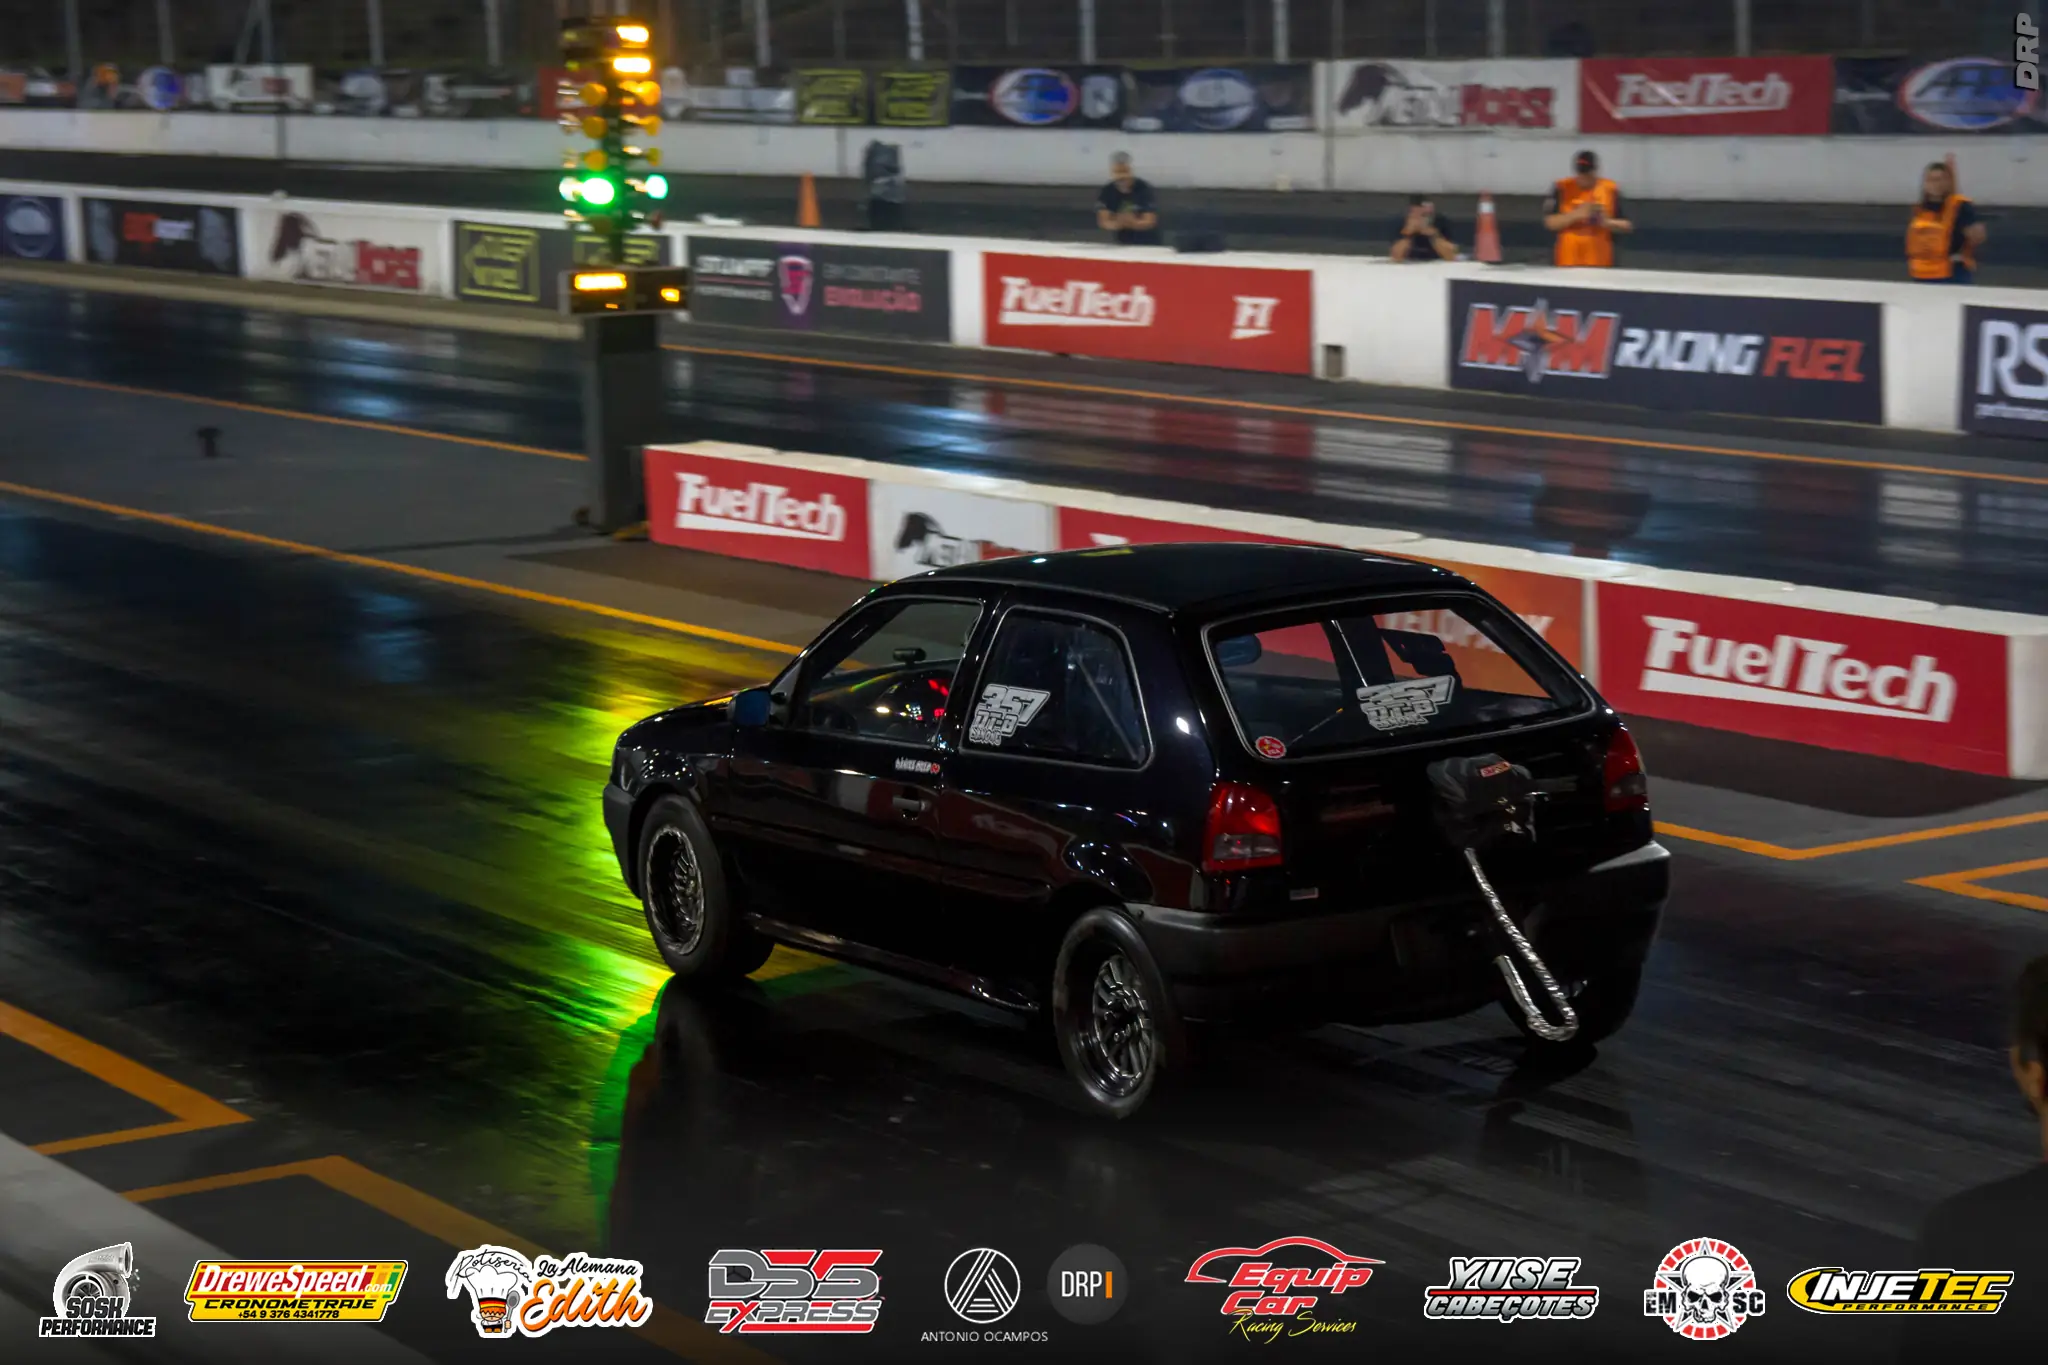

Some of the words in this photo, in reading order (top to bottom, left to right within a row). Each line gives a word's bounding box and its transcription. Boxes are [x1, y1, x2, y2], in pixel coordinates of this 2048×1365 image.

[1616, 73, 1792, 112] FuelTech
[1000, 276, 1155, 325] FuelTech
[1614, 327, 1764, 376] RACING
[1763, 336, 1865, 382] FUEL
[675, 473, 846, 541] FuelTech
[1641, 615, 1956, 723] FuelTech
